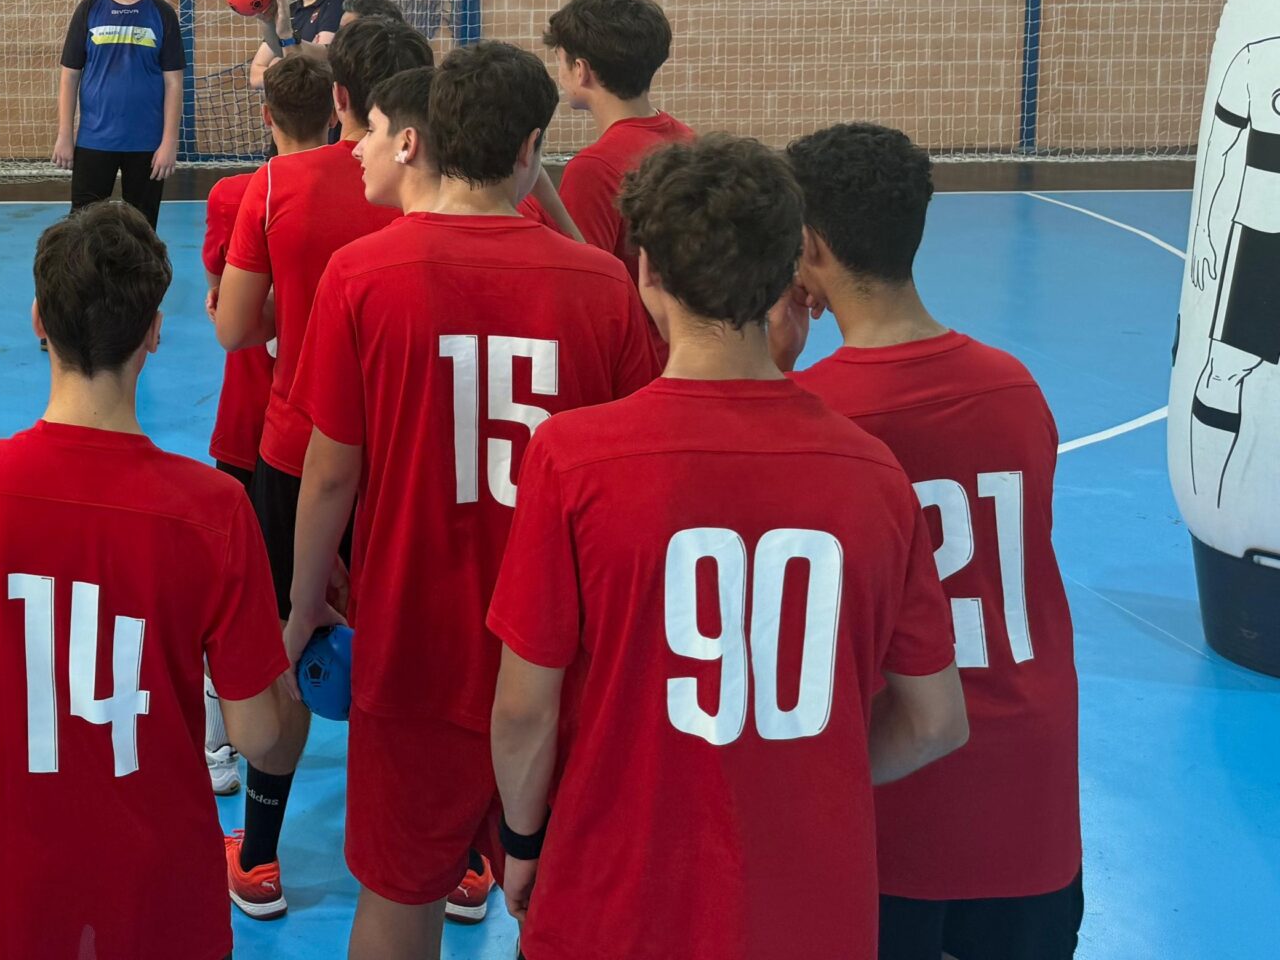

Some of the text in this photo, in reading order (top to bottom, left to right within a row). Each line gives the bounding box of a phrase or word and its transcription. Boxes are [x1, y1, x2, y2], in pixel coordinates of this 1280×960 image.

[439, 334, 558, 508] 15
[664, 527, 843, 746] 90
[912, 470, 1034, 668] 21
[8, 573, 150, 777] 14
